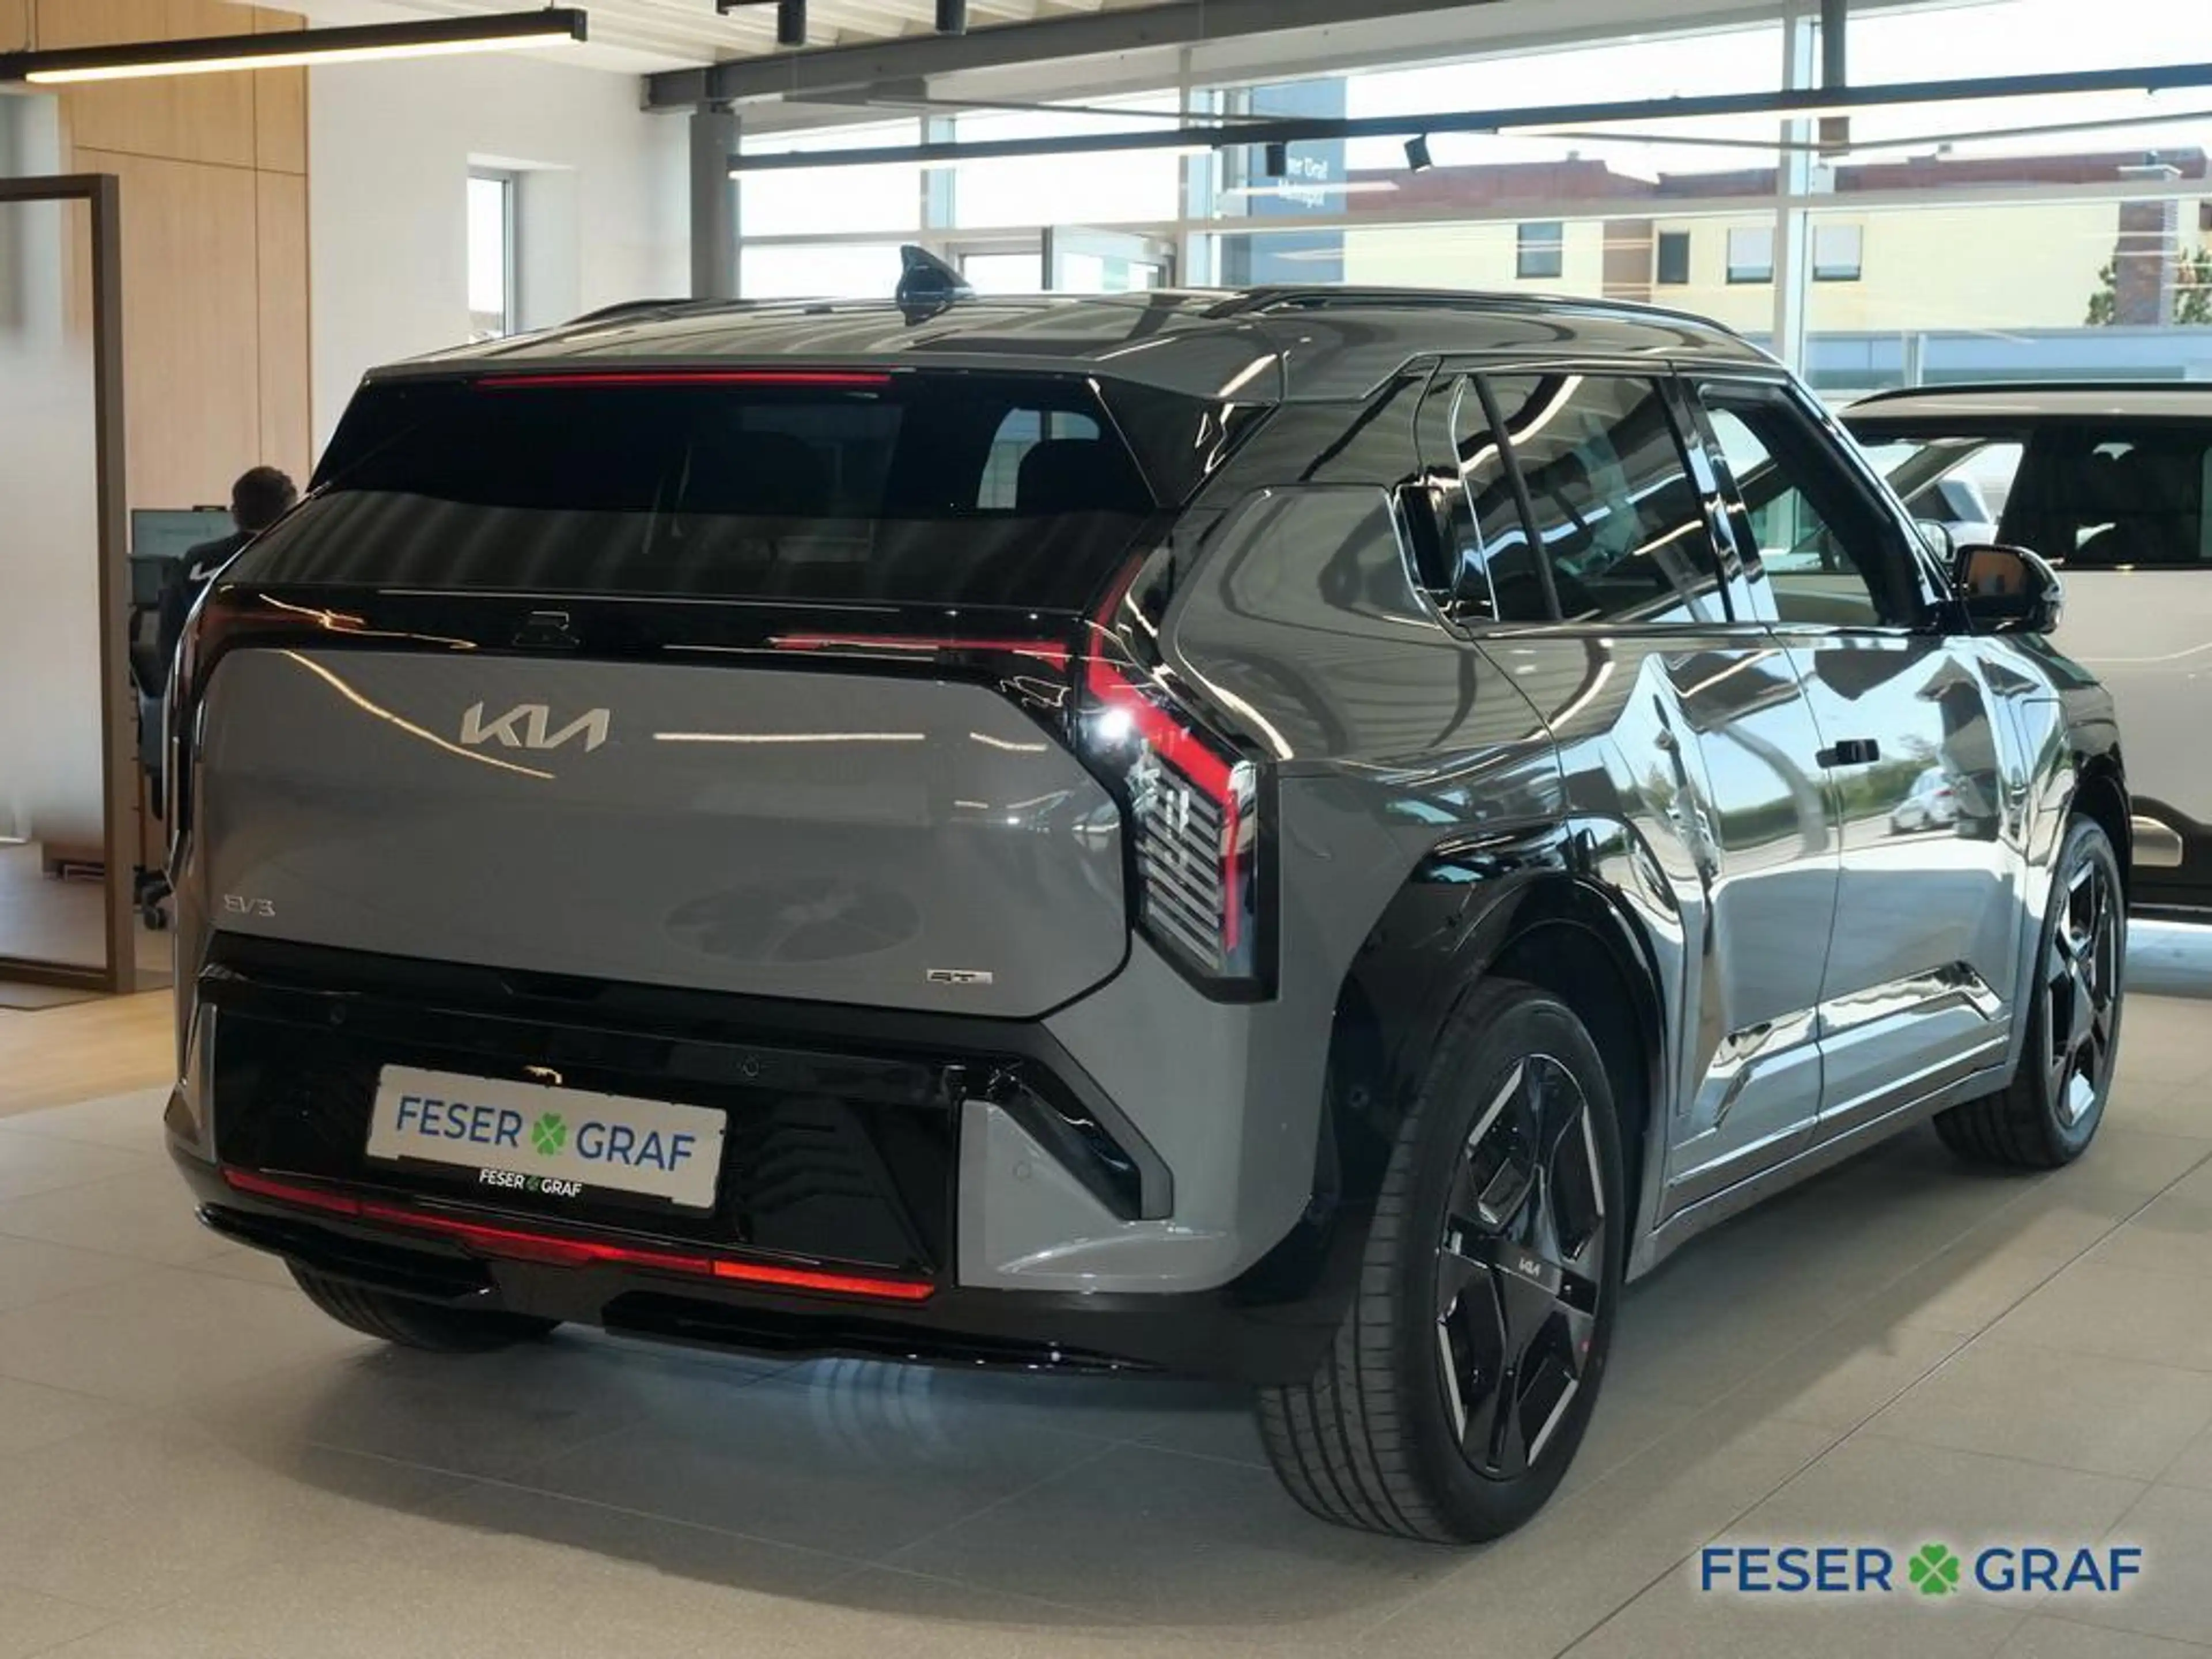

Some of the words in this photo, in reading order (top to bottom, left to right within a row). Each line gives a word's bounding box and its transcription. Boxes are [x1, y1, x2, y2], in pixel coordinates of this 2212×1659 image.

[460, 700, 610, 752] KIA
[224, 894, 276, 917] EV3
[396, 1097, 523, 1147] FESER
[576, 1123, 696, 1172] GRAF
[479, 1168, 525, 1190] FESER
[541, 1179, 582, 1198] GRAF
